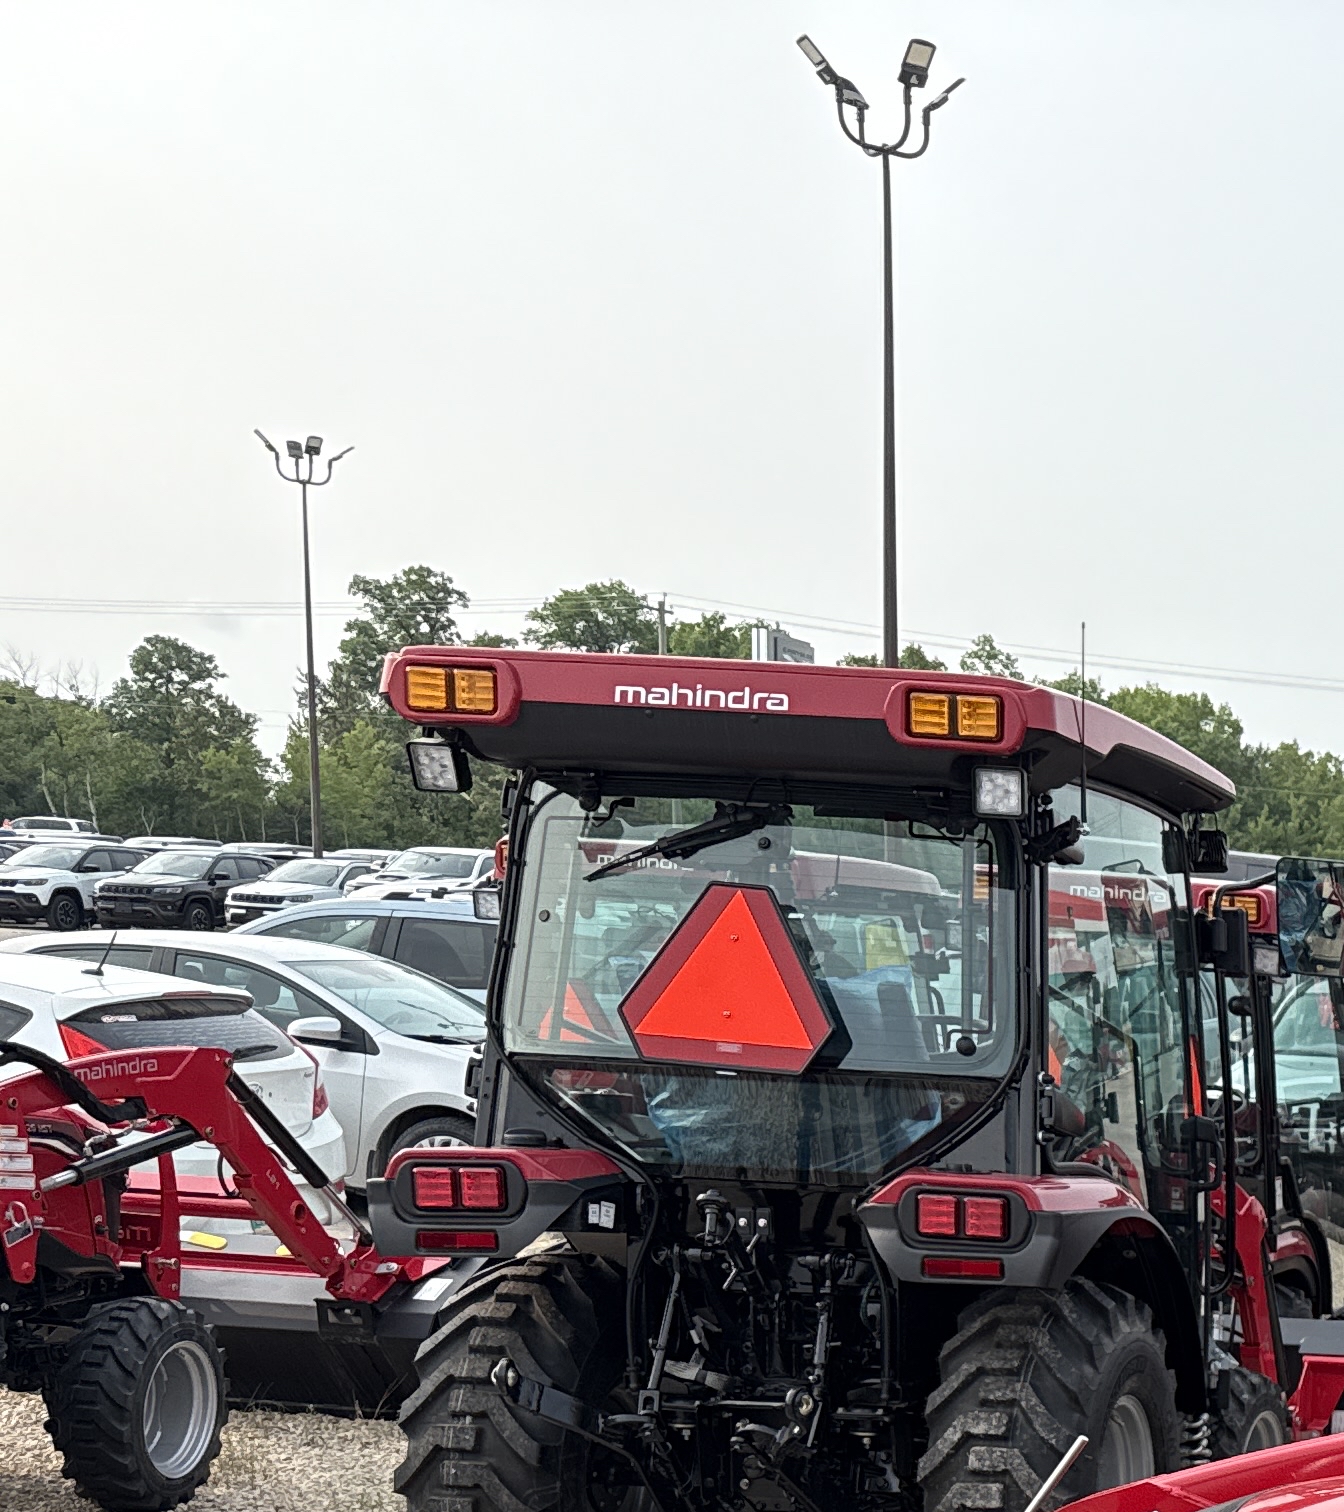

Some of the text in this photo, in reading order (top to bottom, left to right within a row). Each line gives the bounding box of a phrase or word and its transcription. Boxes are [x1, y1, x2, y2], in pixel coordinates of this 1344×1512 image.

[614, 683, 789, 711] mahindra
[1069, 885, 1167, 903] mahindra
[73, 1057, 158, 1082] mahindra
